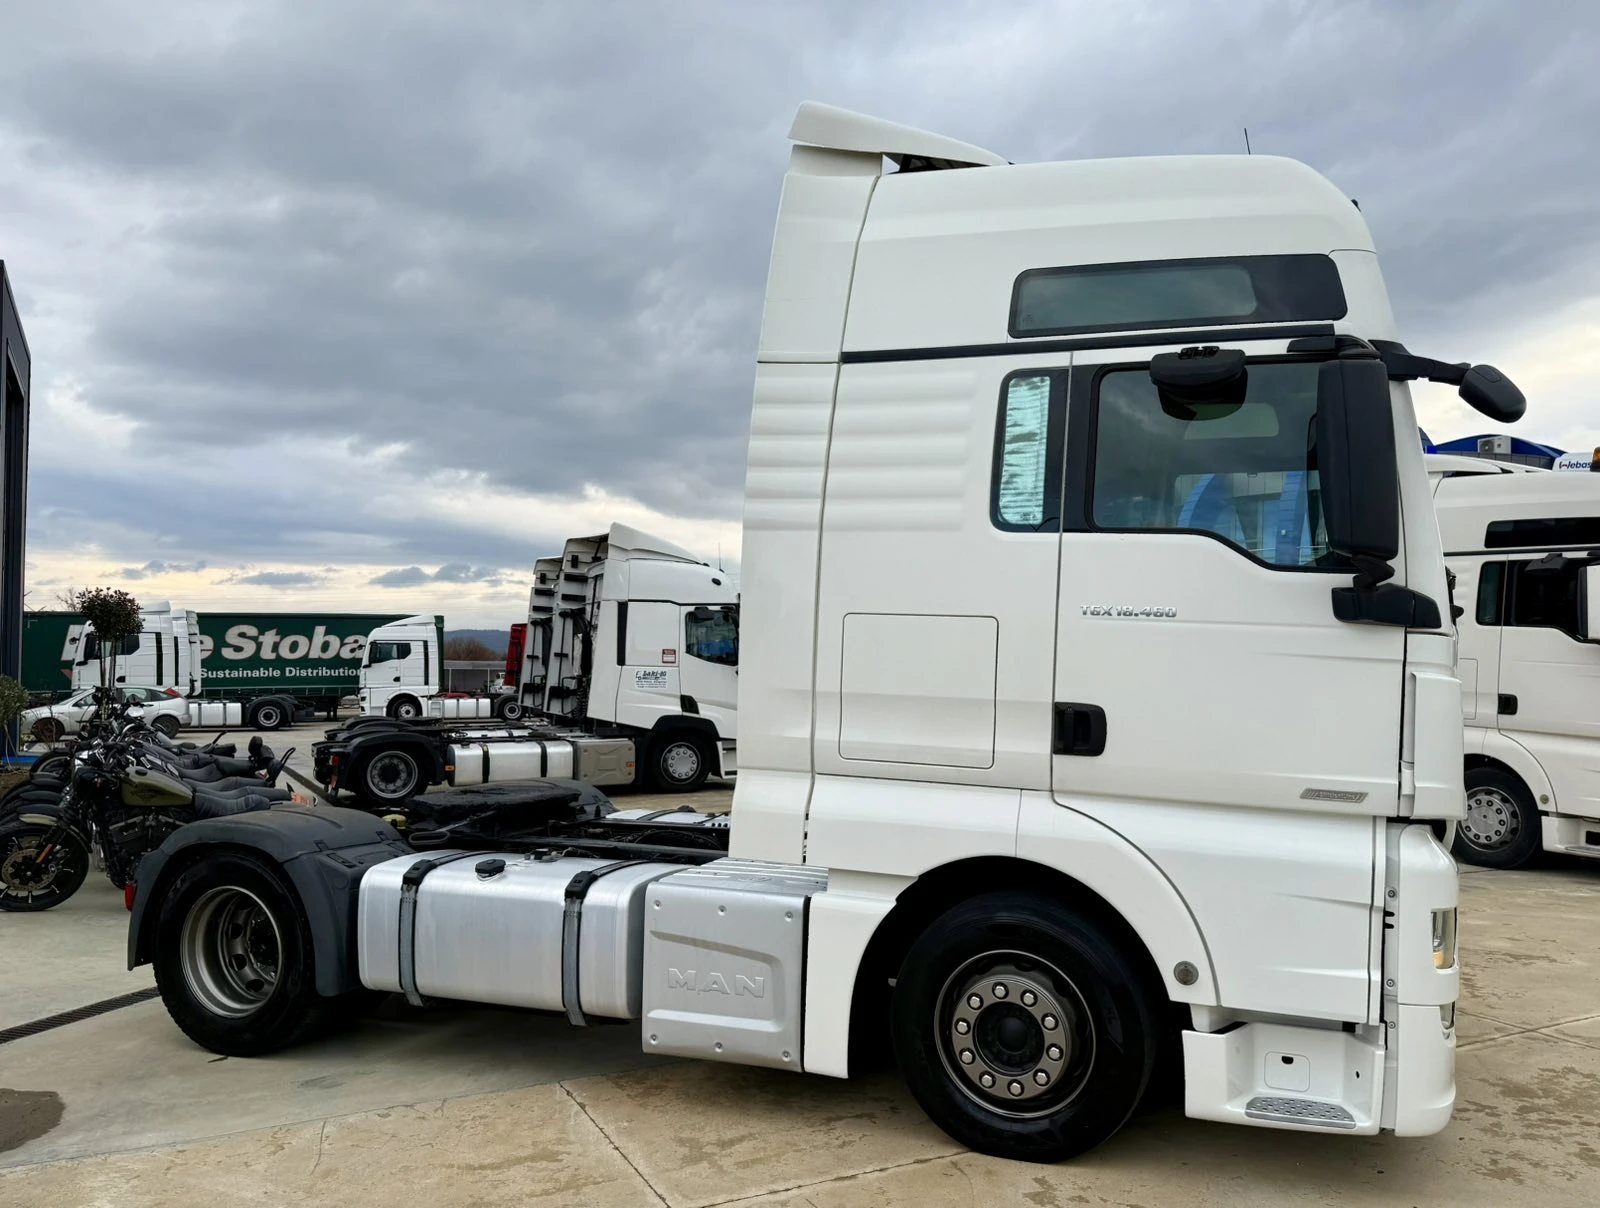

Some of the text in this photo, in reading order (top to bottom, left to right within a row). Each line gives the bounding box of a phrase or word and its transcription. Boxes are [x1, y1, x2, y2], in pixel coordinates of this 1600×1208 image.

[1080, 604, 1113, 617] TGX
[200, 667, 281, 679] Sustainable
[668, 968, 764, 998] MAN
